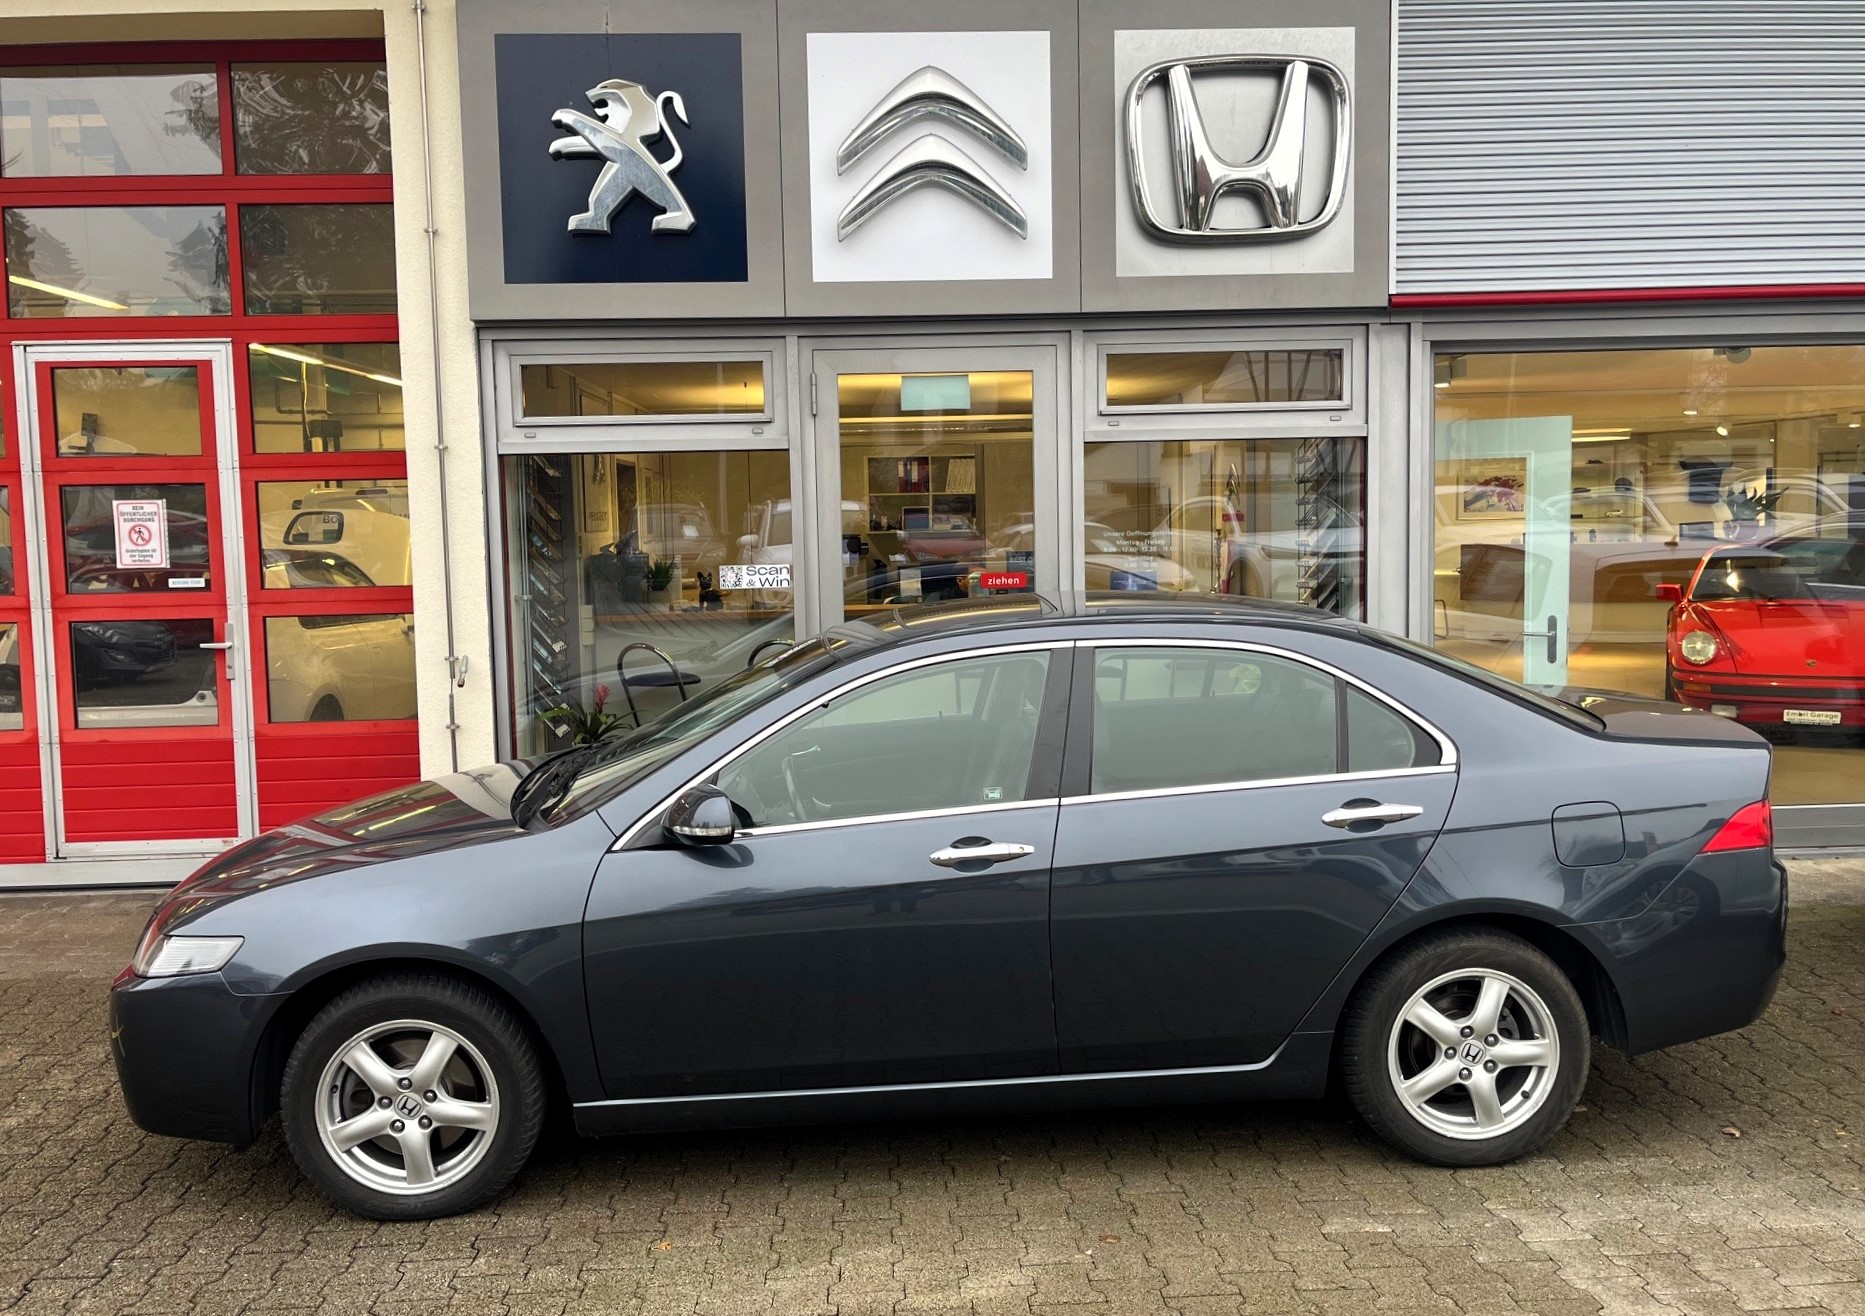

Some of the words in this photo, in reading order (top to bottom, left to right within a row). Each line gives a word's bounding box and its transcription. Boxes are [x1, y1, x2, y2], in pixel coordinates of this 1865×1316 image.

[746, 565, 790, 576] Scan
[746, 579, 756, 587] &
[758, 576, 790, 587] Win
[987, 576, 1020, 585] ziehen
